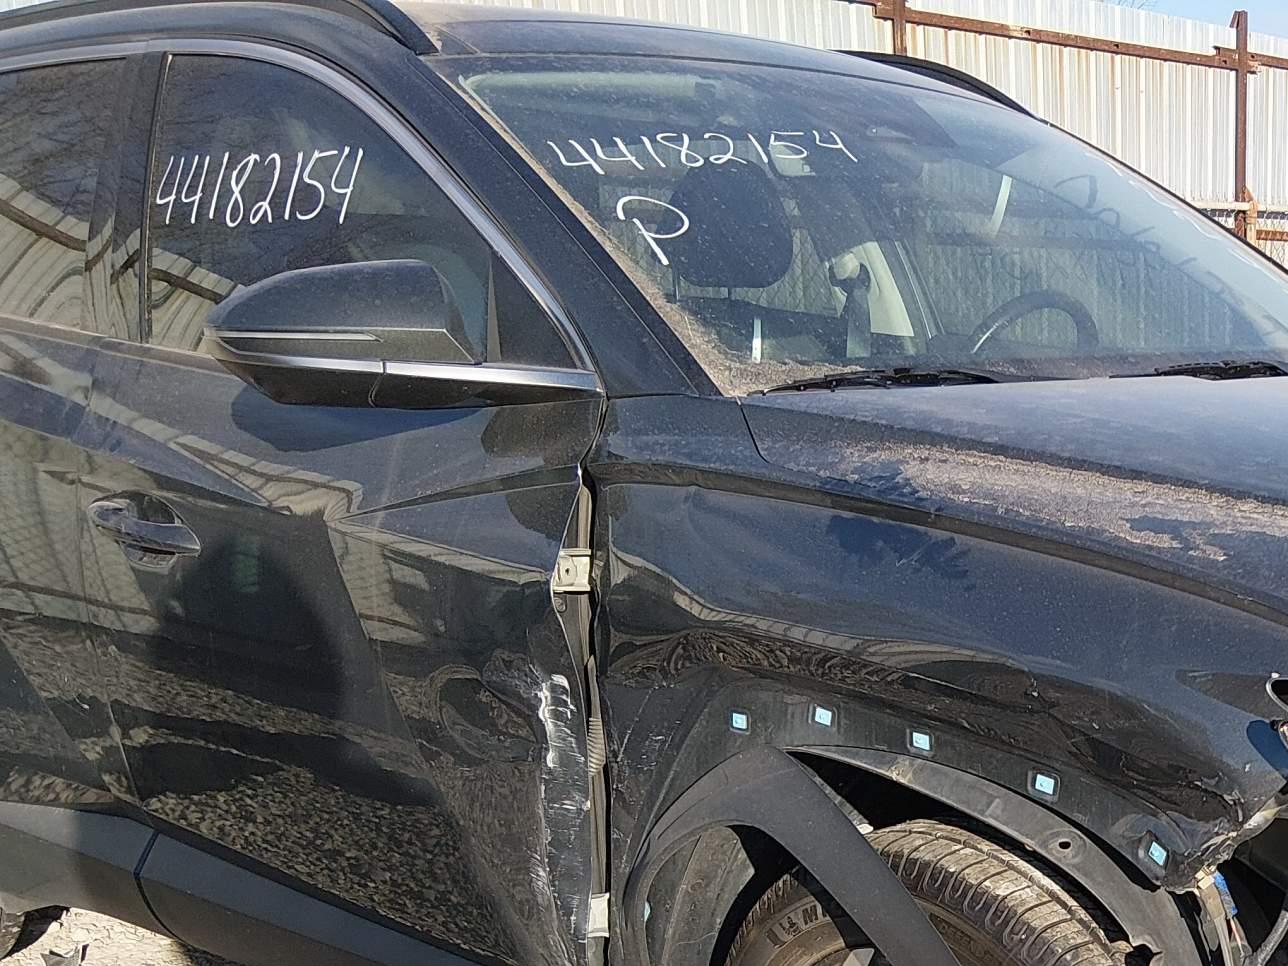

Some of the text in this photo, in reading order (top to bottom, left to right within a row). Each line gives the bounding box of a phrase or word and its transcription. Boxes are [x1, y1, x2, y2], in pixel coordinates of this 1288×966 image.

[156, 146, 364, 227] 44182154
[547, 130, 858, 175] 44182154
[616, 196, 690, 265] P
